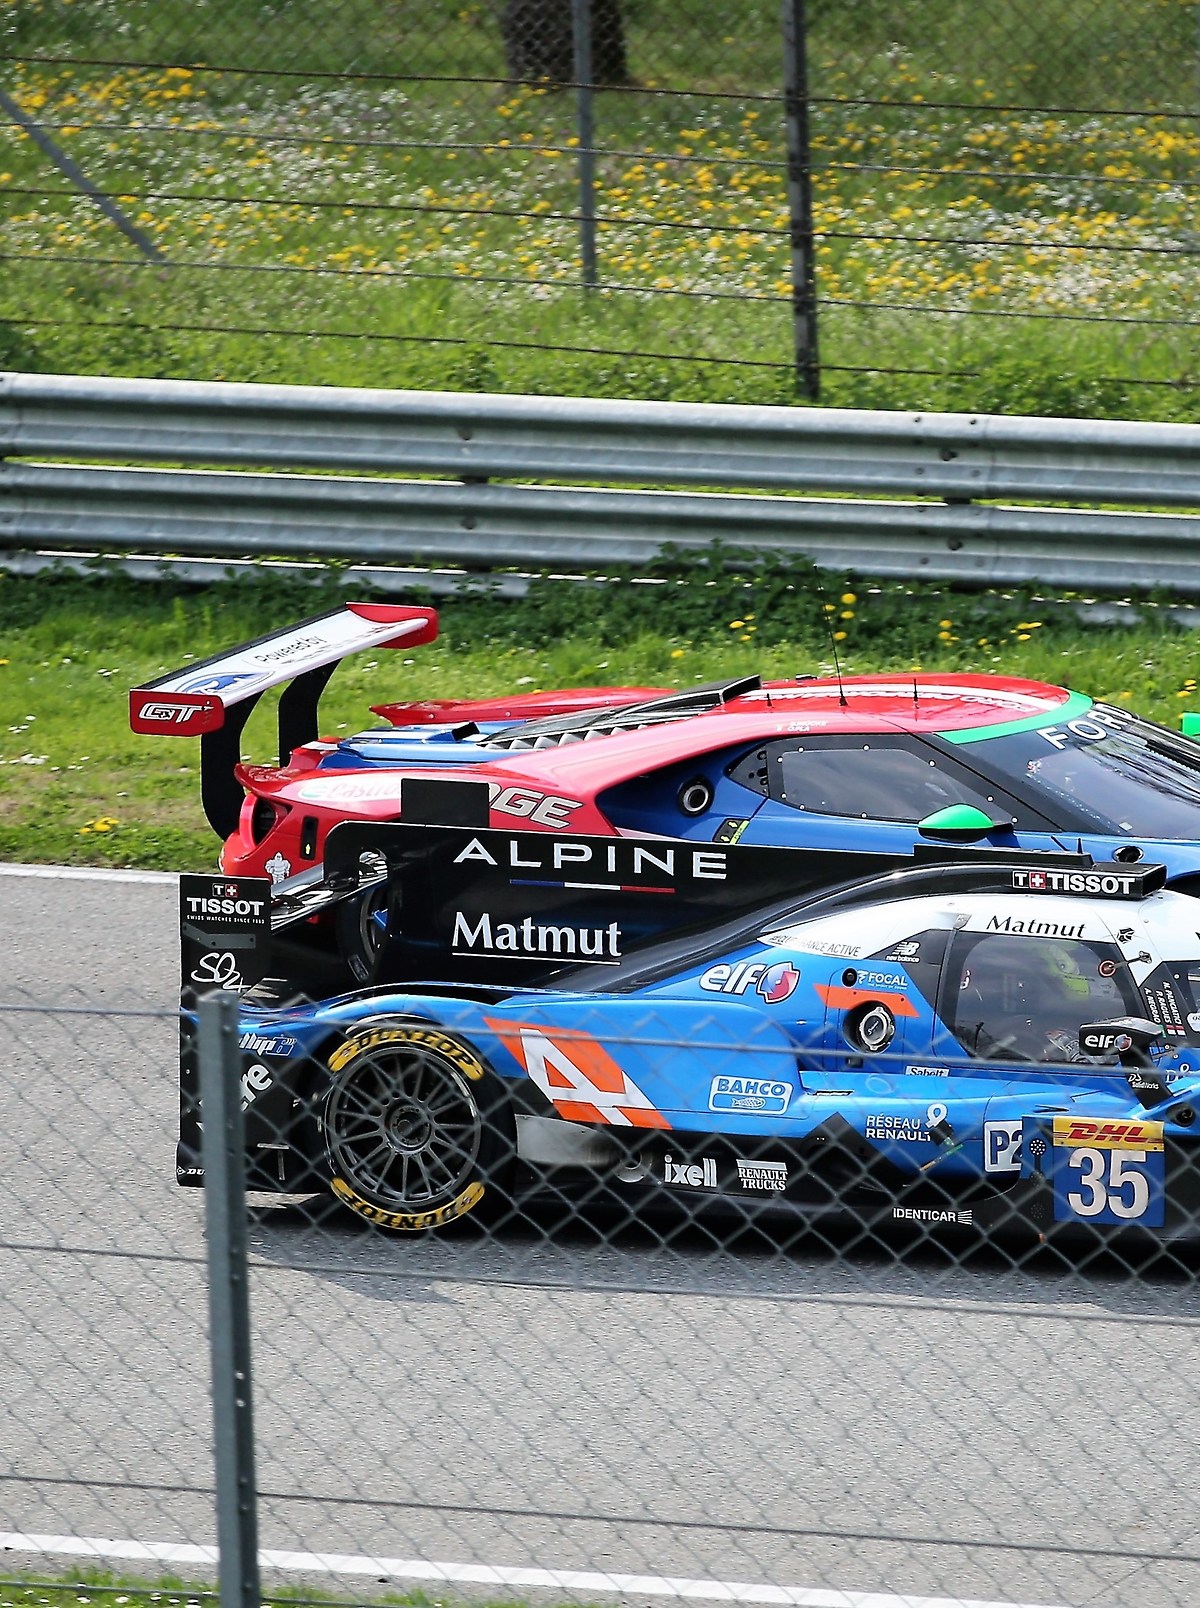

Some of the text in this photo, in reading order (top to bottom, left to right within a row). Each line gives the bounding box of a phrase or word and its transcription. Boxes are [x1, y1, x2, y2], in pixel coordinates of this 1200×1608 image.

[254, 640, 305, 662] Powered
[138, 702, 207, 724] GT
[1036, 703, 1133, 750] FORD
[453, 838, 727, 880] ALPINE
[1050, 872, 1136, 895] TISSOT
[186, 897, 264, 916] TISSOT
[452, 911, 622, 957] Matmut
[986, 914, 1087, 939] Matmut
[826, 943, 861, 957] ACTIVE
[700, 962, 768, 995] elf
[868, 972, 908, 986] FOCAL
[1085, 1034, 1114, 1049] elf
[911, 1066, 945, 1077] Sabelt
[717, 1077, 786, 1097] BAHCO
[866, 1114, 921, 1130] RÉSEAU
[1068, 1122, 1149, 1144] DHL
[865, 1127, 931, 1142] RENAULT
[993, 1129, 1023, 1167] P2
[664, 1154, 717, 1188] ixell
[738, 1167, 788, 1181] RENAULT
[740, 1178, 786, 1191] TRUCKS
[1068, 1147, 1149, 1219] 35
[893, 1208, 957, 1223] IDENTICAR
